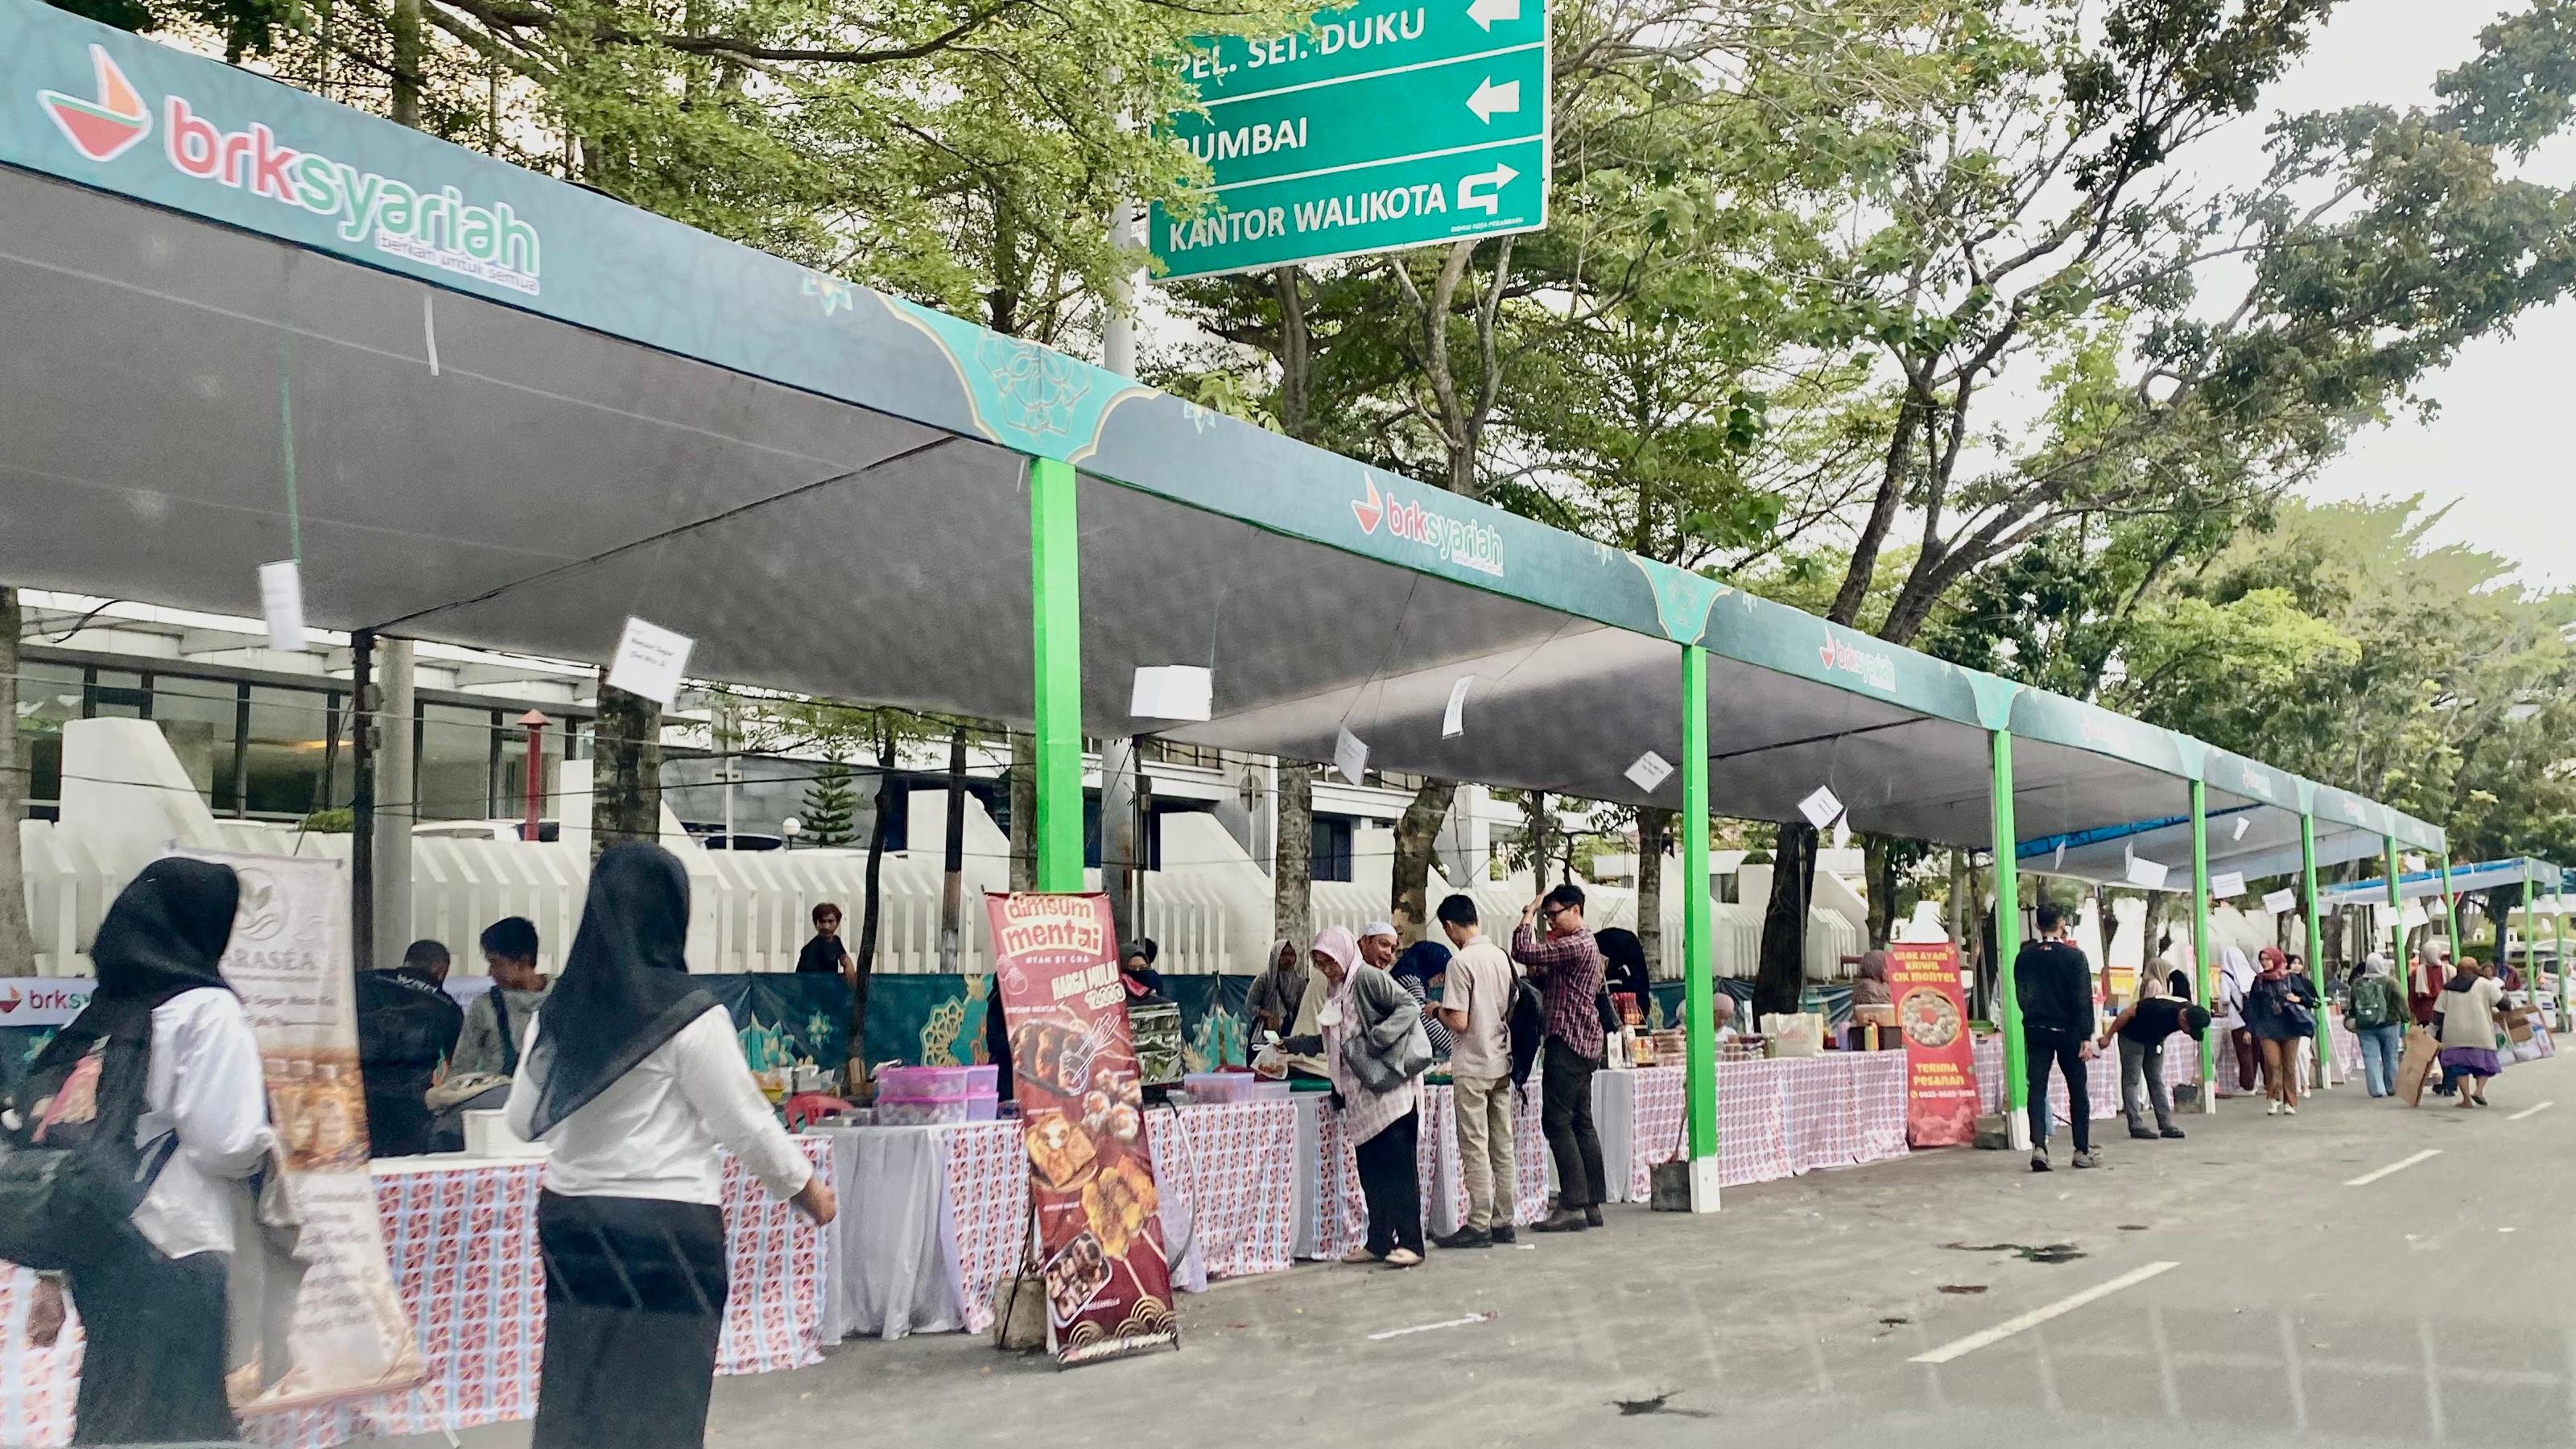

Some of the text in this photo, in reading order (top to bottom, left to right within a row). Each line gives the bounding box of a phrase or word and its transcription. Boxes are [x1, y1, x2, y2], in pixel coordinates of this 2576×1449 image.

[1248, 32, 1308, 68] SEI.
[1321, 7, 1426, 55] DUKU
[164, 93, 541, 275] brksyariah
[1170, 182, 1447, 252] KANTOR WALIKOTA
[1386, 491, 1504, 565] brksyariah
[1007, 920, 1099, 953] mentai
[1008, 895, 1091, 919] dimsum
